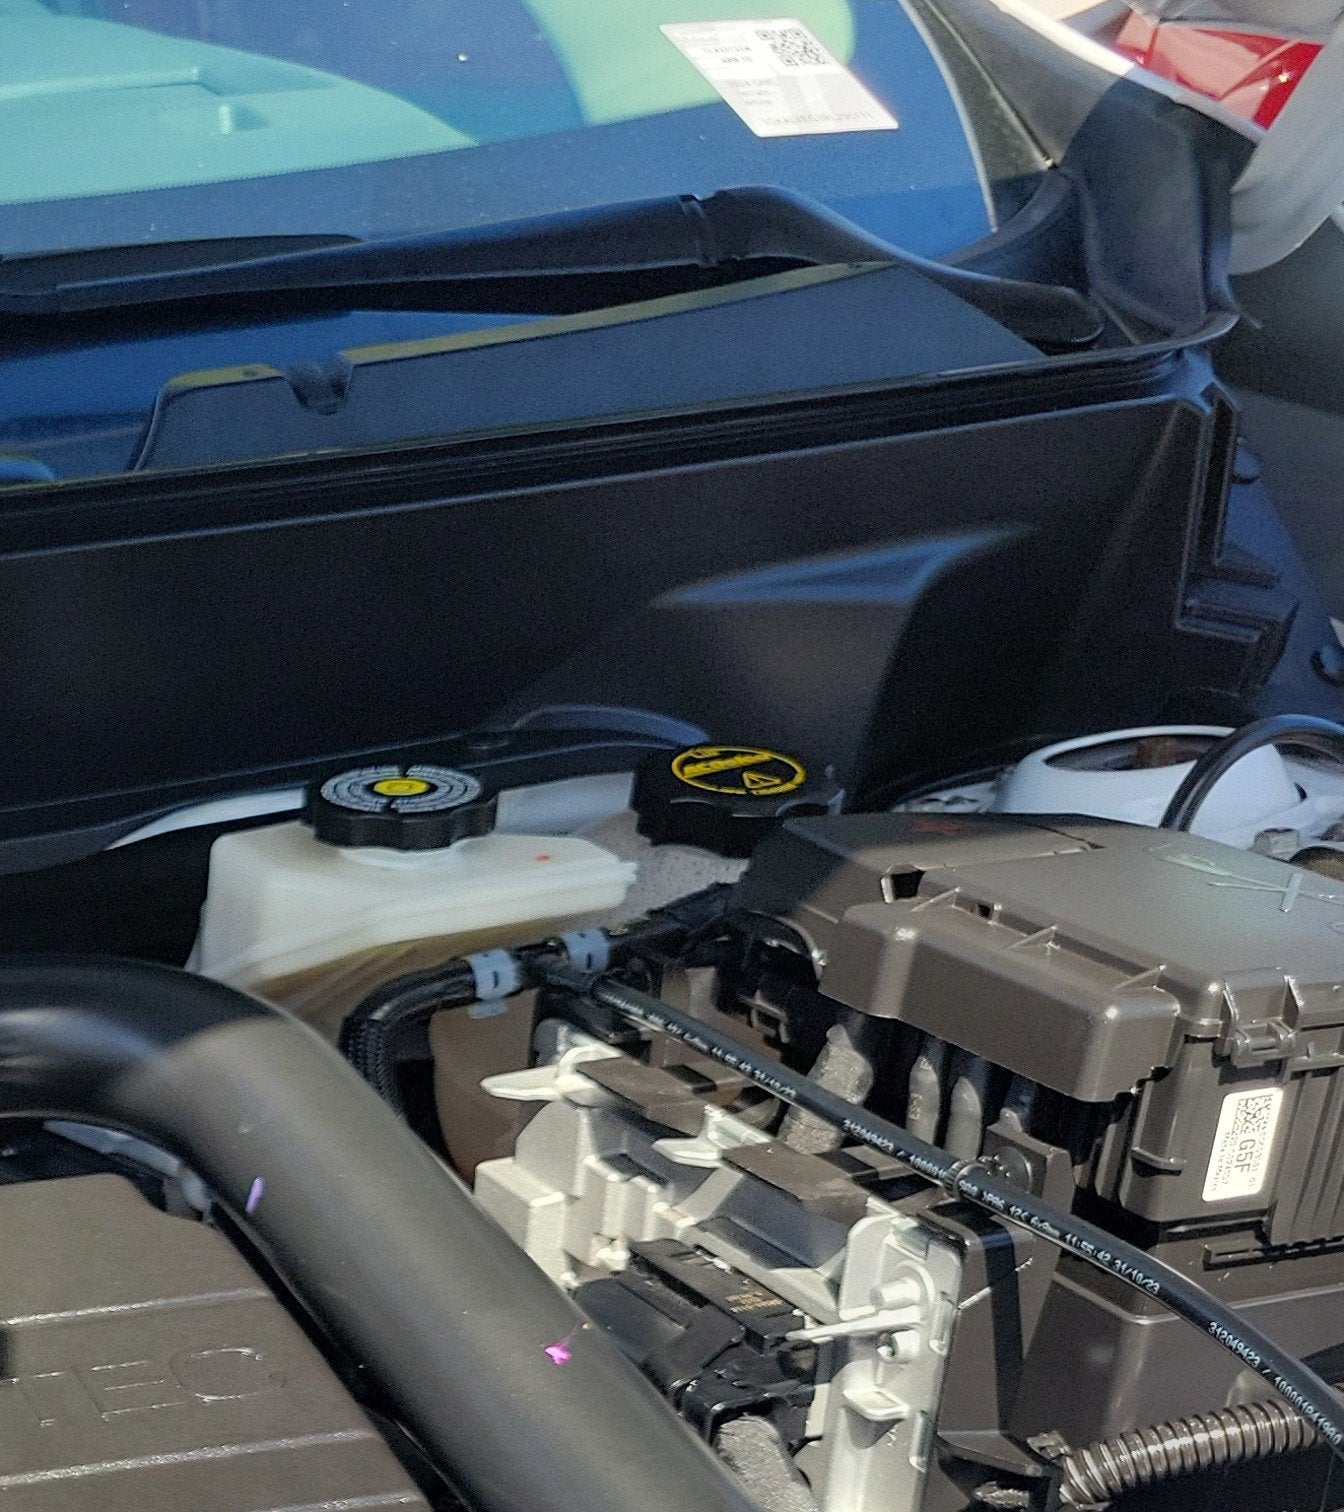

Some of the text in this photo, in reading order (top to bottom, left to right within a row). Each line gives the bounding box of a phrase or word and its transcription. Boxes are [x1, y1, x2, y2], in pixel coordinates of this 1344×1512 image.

[1234, 1138, 1256, 1173] G5F
[1064, 1232, 1111, 1266] 11:55:42
[1113, 1259, 1161, 1294] 31/10/23
[1209, 1321, 1261, 1367] 312049423
